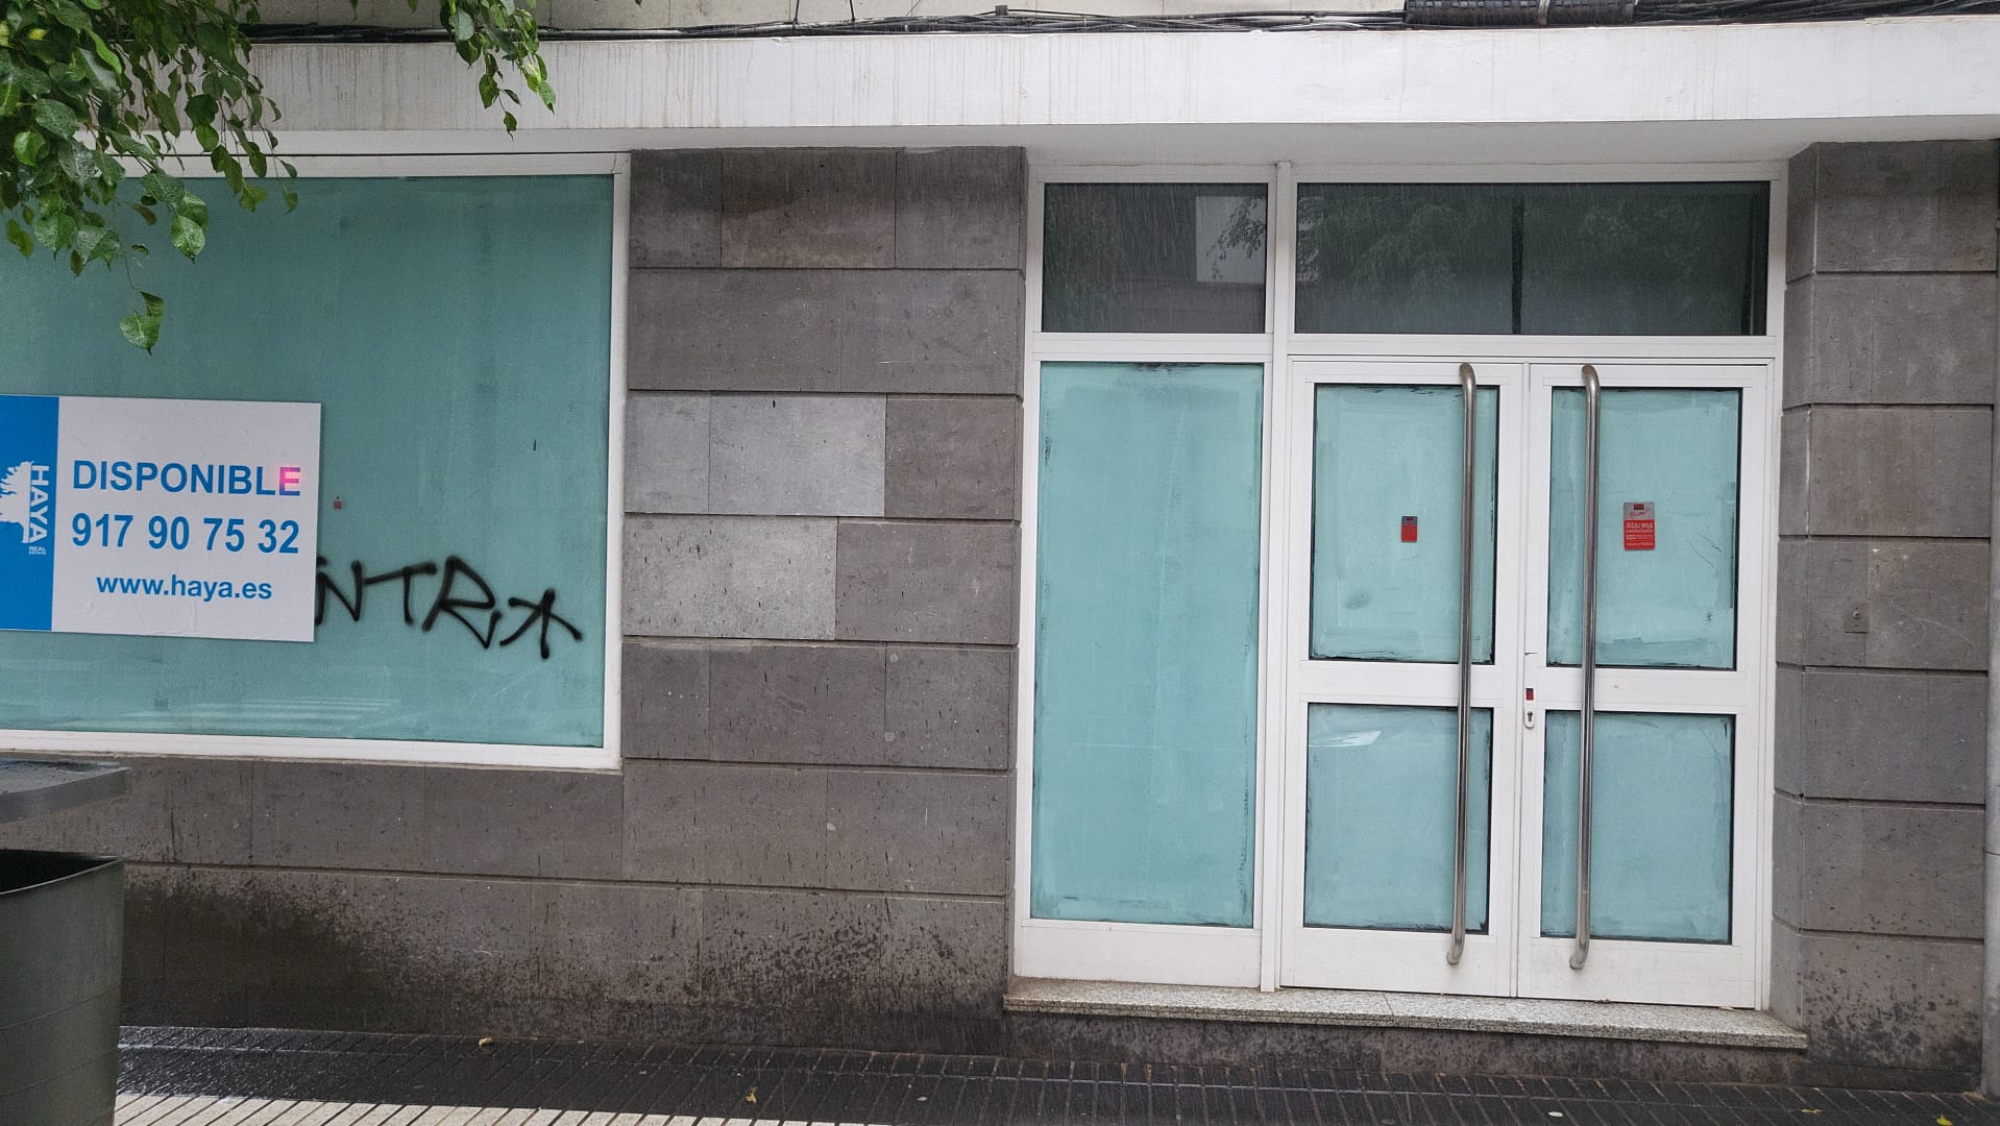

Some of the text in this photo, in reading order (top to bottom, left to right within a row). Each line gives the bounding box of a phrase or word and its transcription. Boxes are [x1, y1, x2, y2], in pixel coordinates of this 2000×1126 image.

[73, 460, 301, 497] DISPONIBLE
[29, 465, 50, 543] HAYA
[72, 512, 300, 554] 917 90 75 32
[96, 574, 272, 602] www.haya.es
